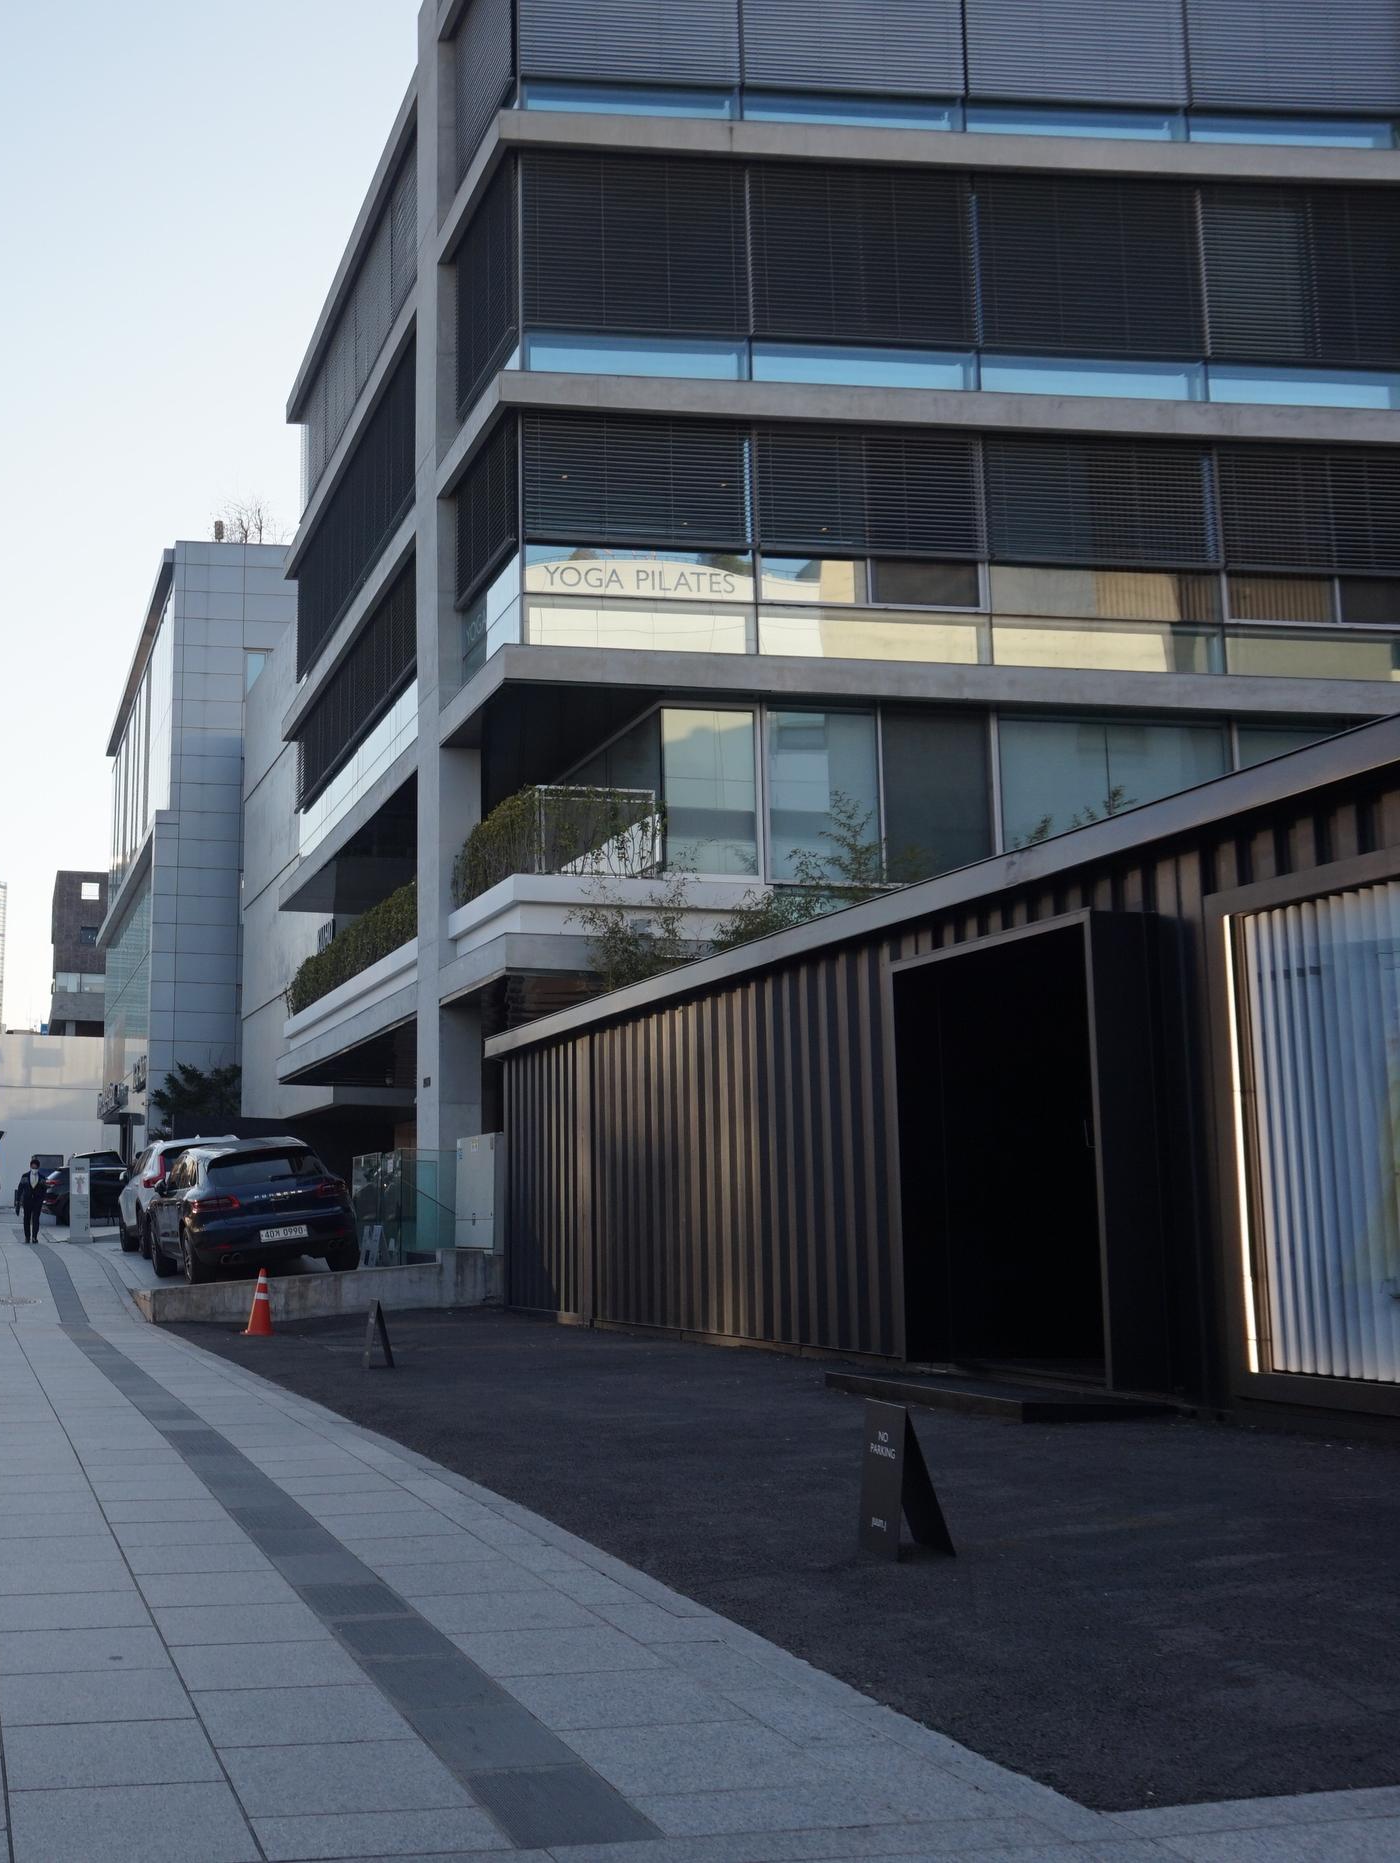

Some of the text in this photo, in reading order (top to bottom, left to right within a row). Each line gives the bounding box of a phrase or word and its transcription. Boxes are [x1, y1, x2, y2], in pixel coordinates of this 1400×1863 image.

[544, 565, 736, 594] YOGA PILATES
[878, 1431, 889, 1442] NO
[870, 1443, 896, 1459] PARKING
